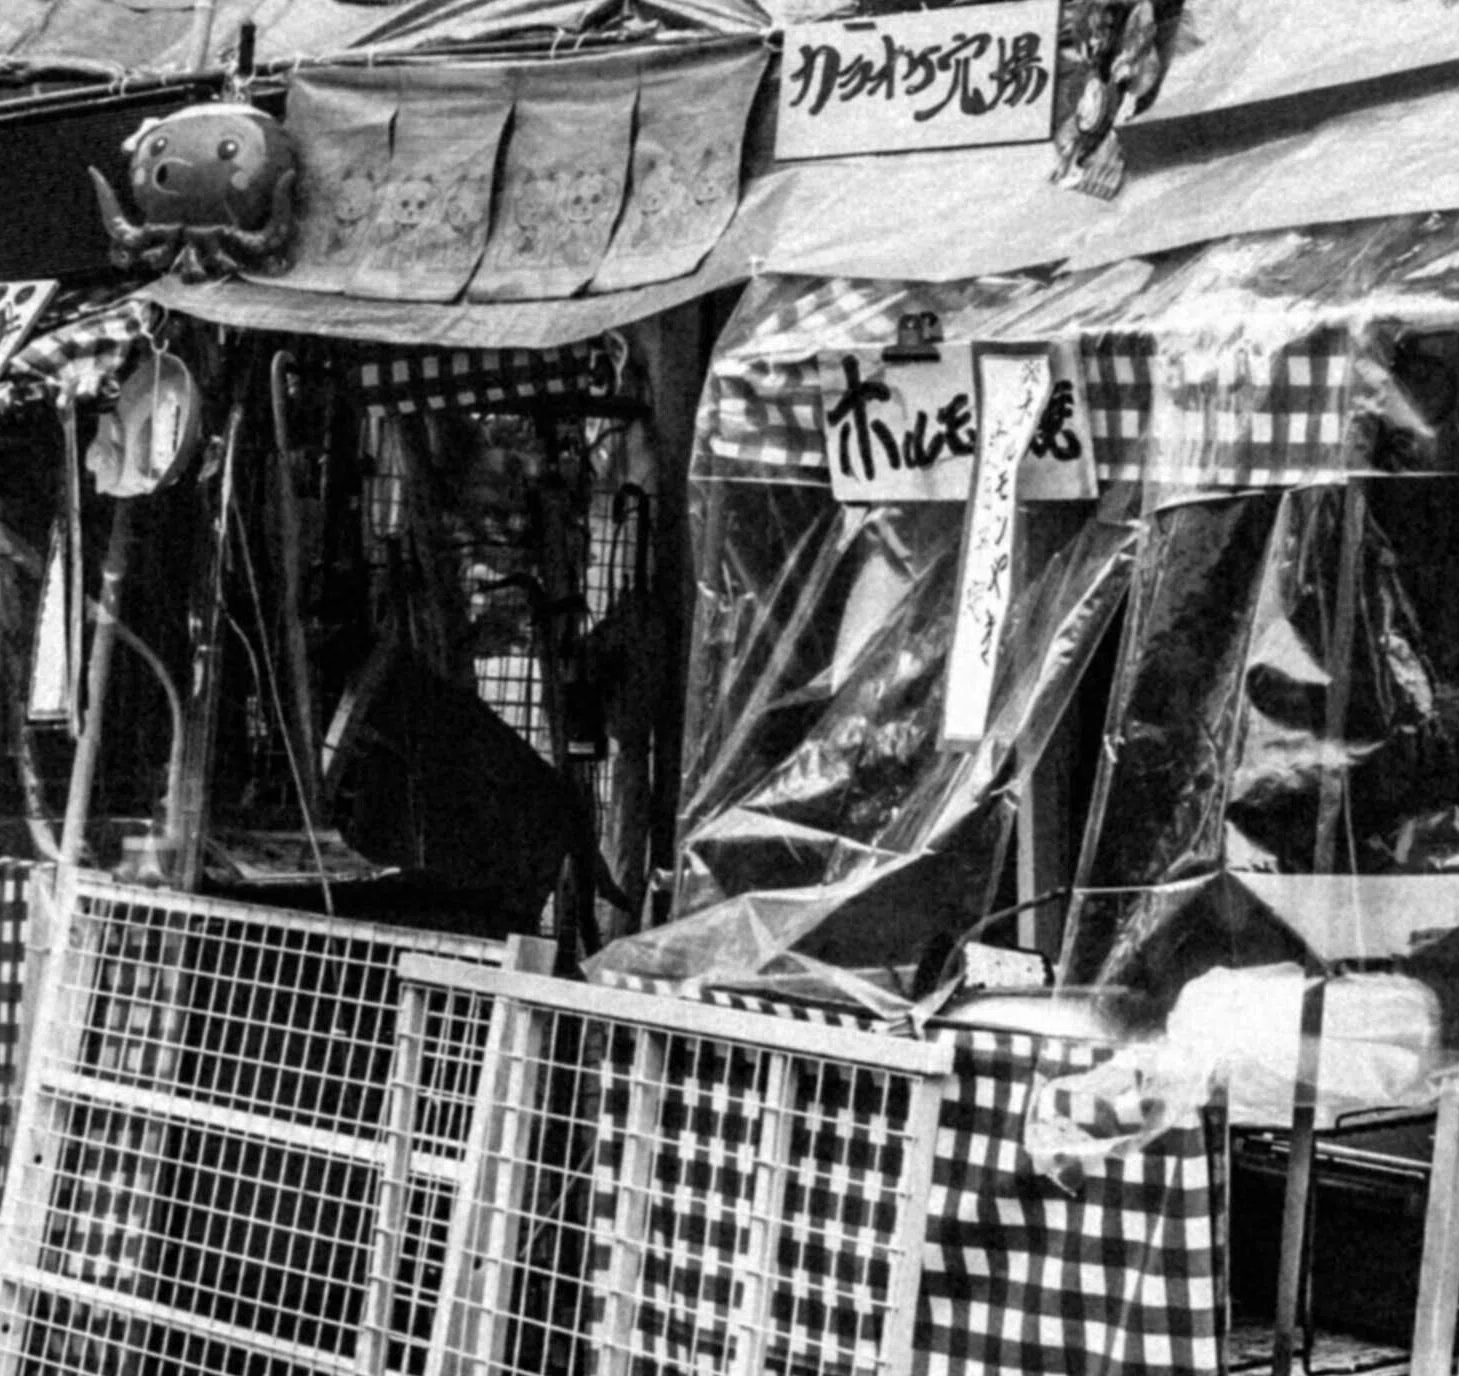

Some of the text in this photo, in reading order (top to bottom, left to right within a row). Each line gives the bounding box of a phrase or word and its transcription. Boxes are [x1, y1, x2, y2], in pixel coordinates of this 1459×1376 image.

[789, 29, 1049, 122] カラオケ穴場
